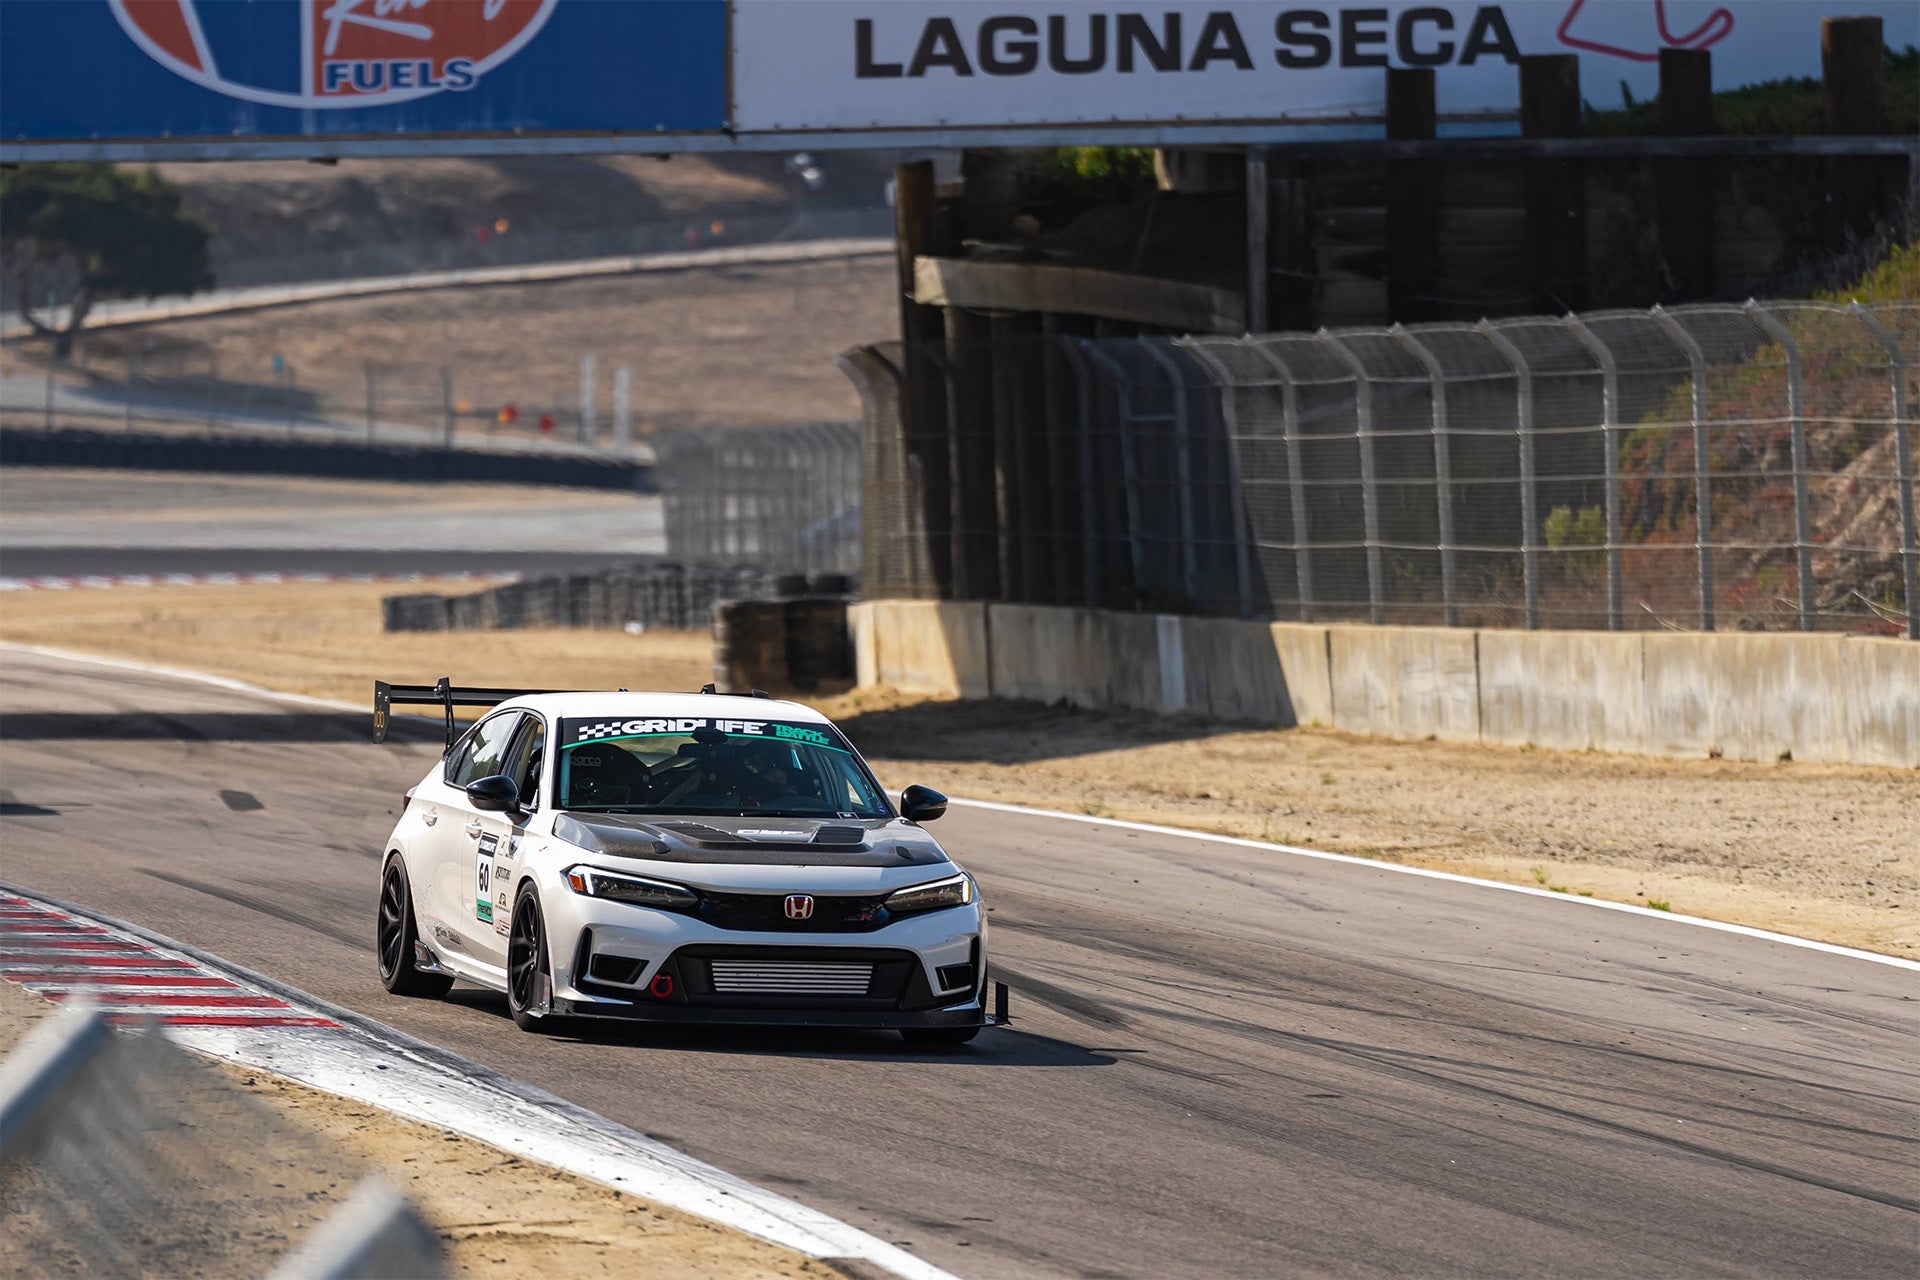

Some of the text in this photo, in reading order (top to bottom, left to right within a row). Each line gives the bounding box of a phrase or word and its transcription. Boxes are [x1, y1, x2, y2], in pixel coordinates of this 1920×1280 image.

[855, 6, 1519, 79] LAGUNA SECA
[323, 57, 478, 91] FUELS
[772, 724, 824, 737] TRACK
[479, 862, 489, 893] 60
